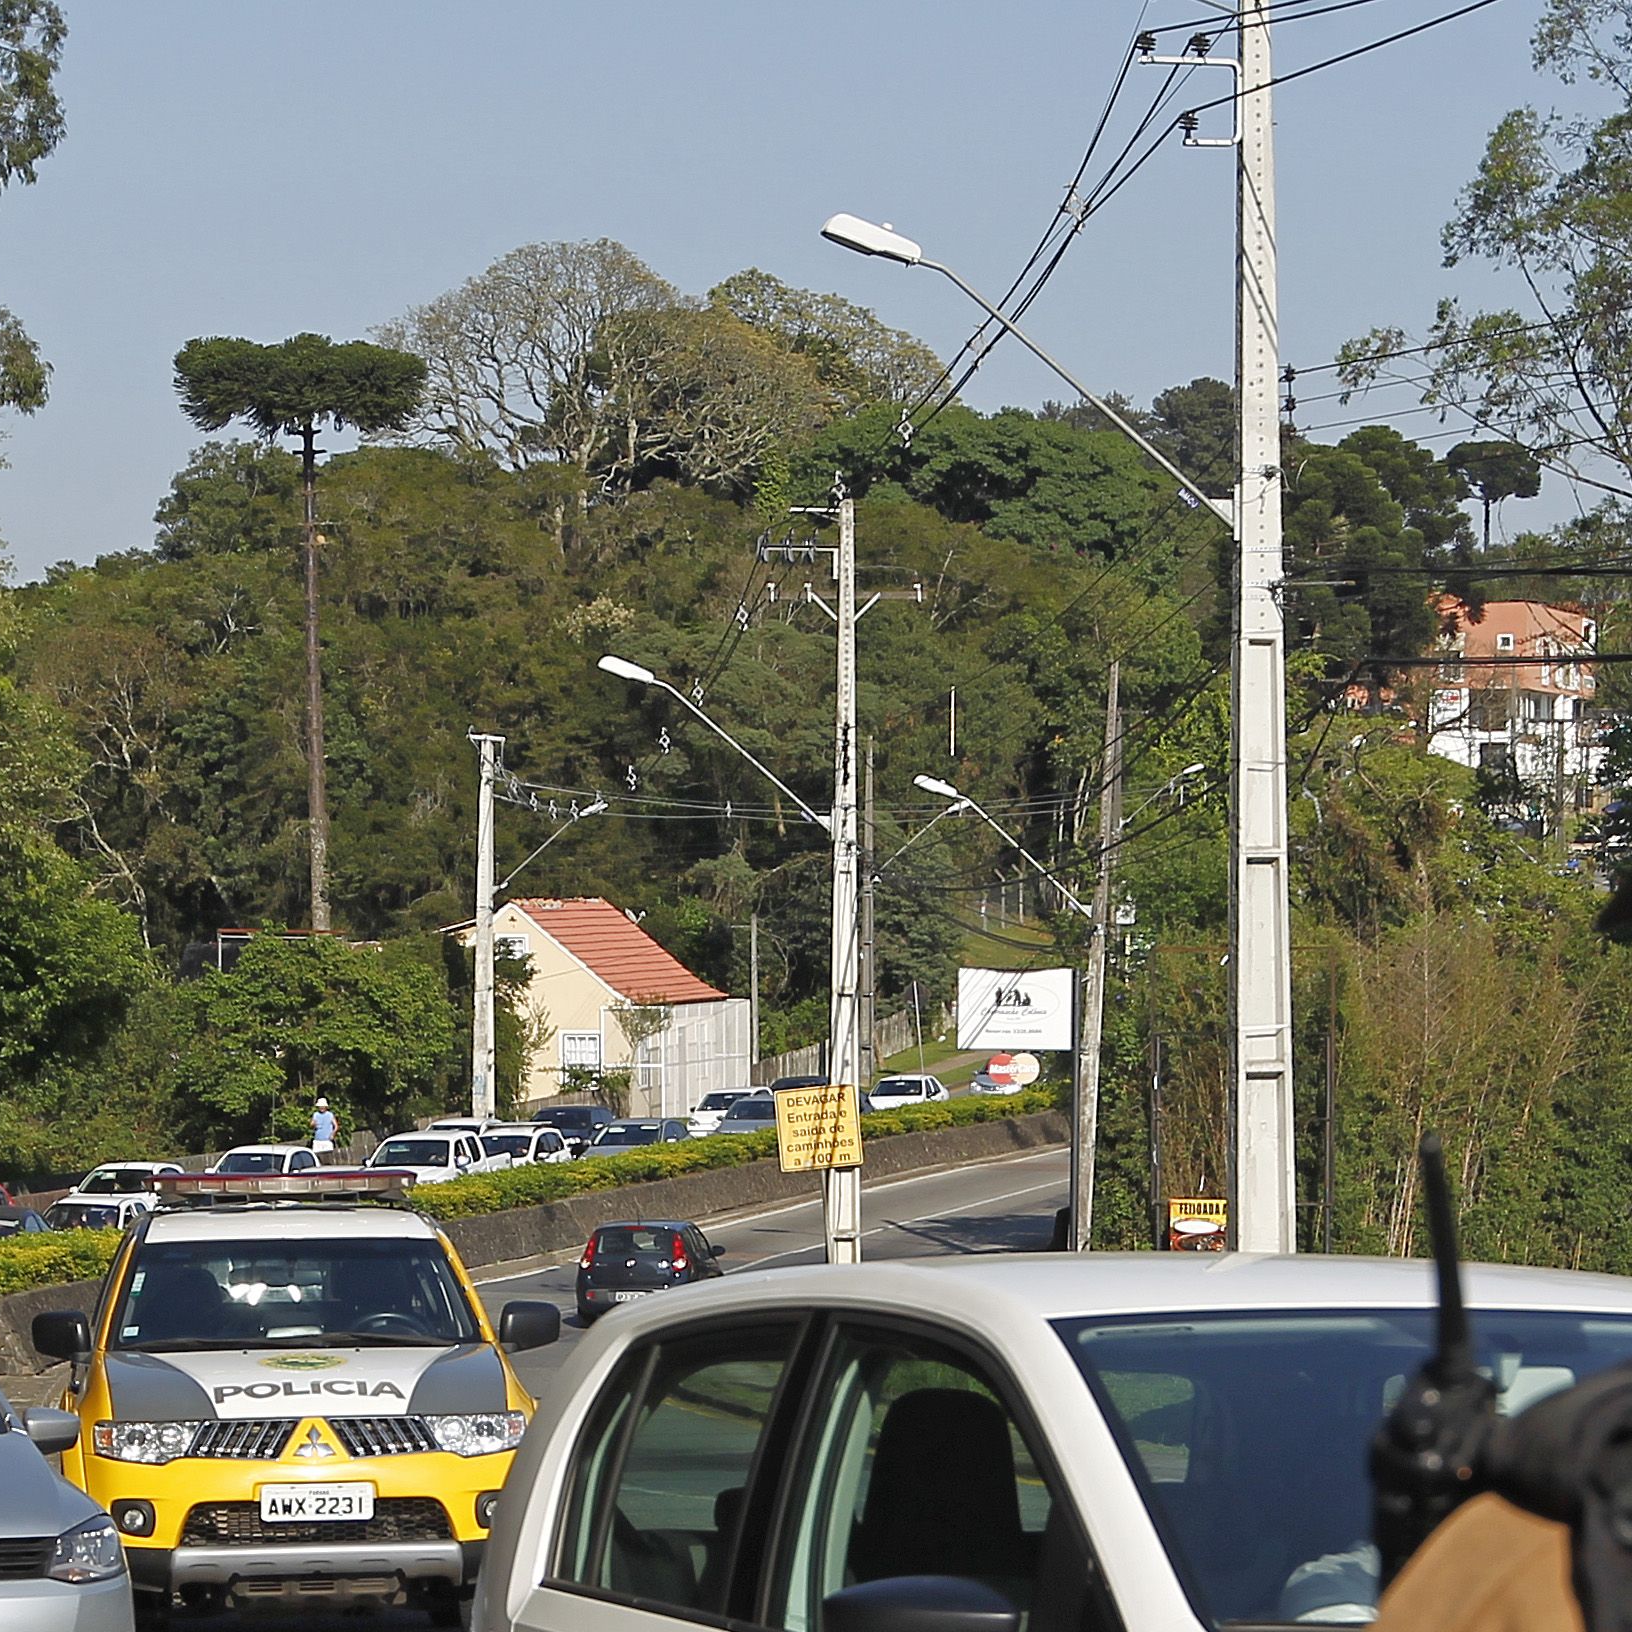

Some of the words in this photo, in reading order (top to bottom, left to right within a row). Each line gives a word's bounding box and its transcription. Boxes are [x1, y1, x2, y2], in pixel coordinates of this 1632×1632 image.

[786, 1092, 847, 1108] DEVAGAR
[787, 1109, 837, 1124] Entrada
[829, 1123, 845, 1134] de
[794, 1158, 801, 1166] a
[811, 1152, 833, 1165] 100
[839, 1153, 851, 1162] m
[1179, 1202, 1220, 1216] FEIJOADA
